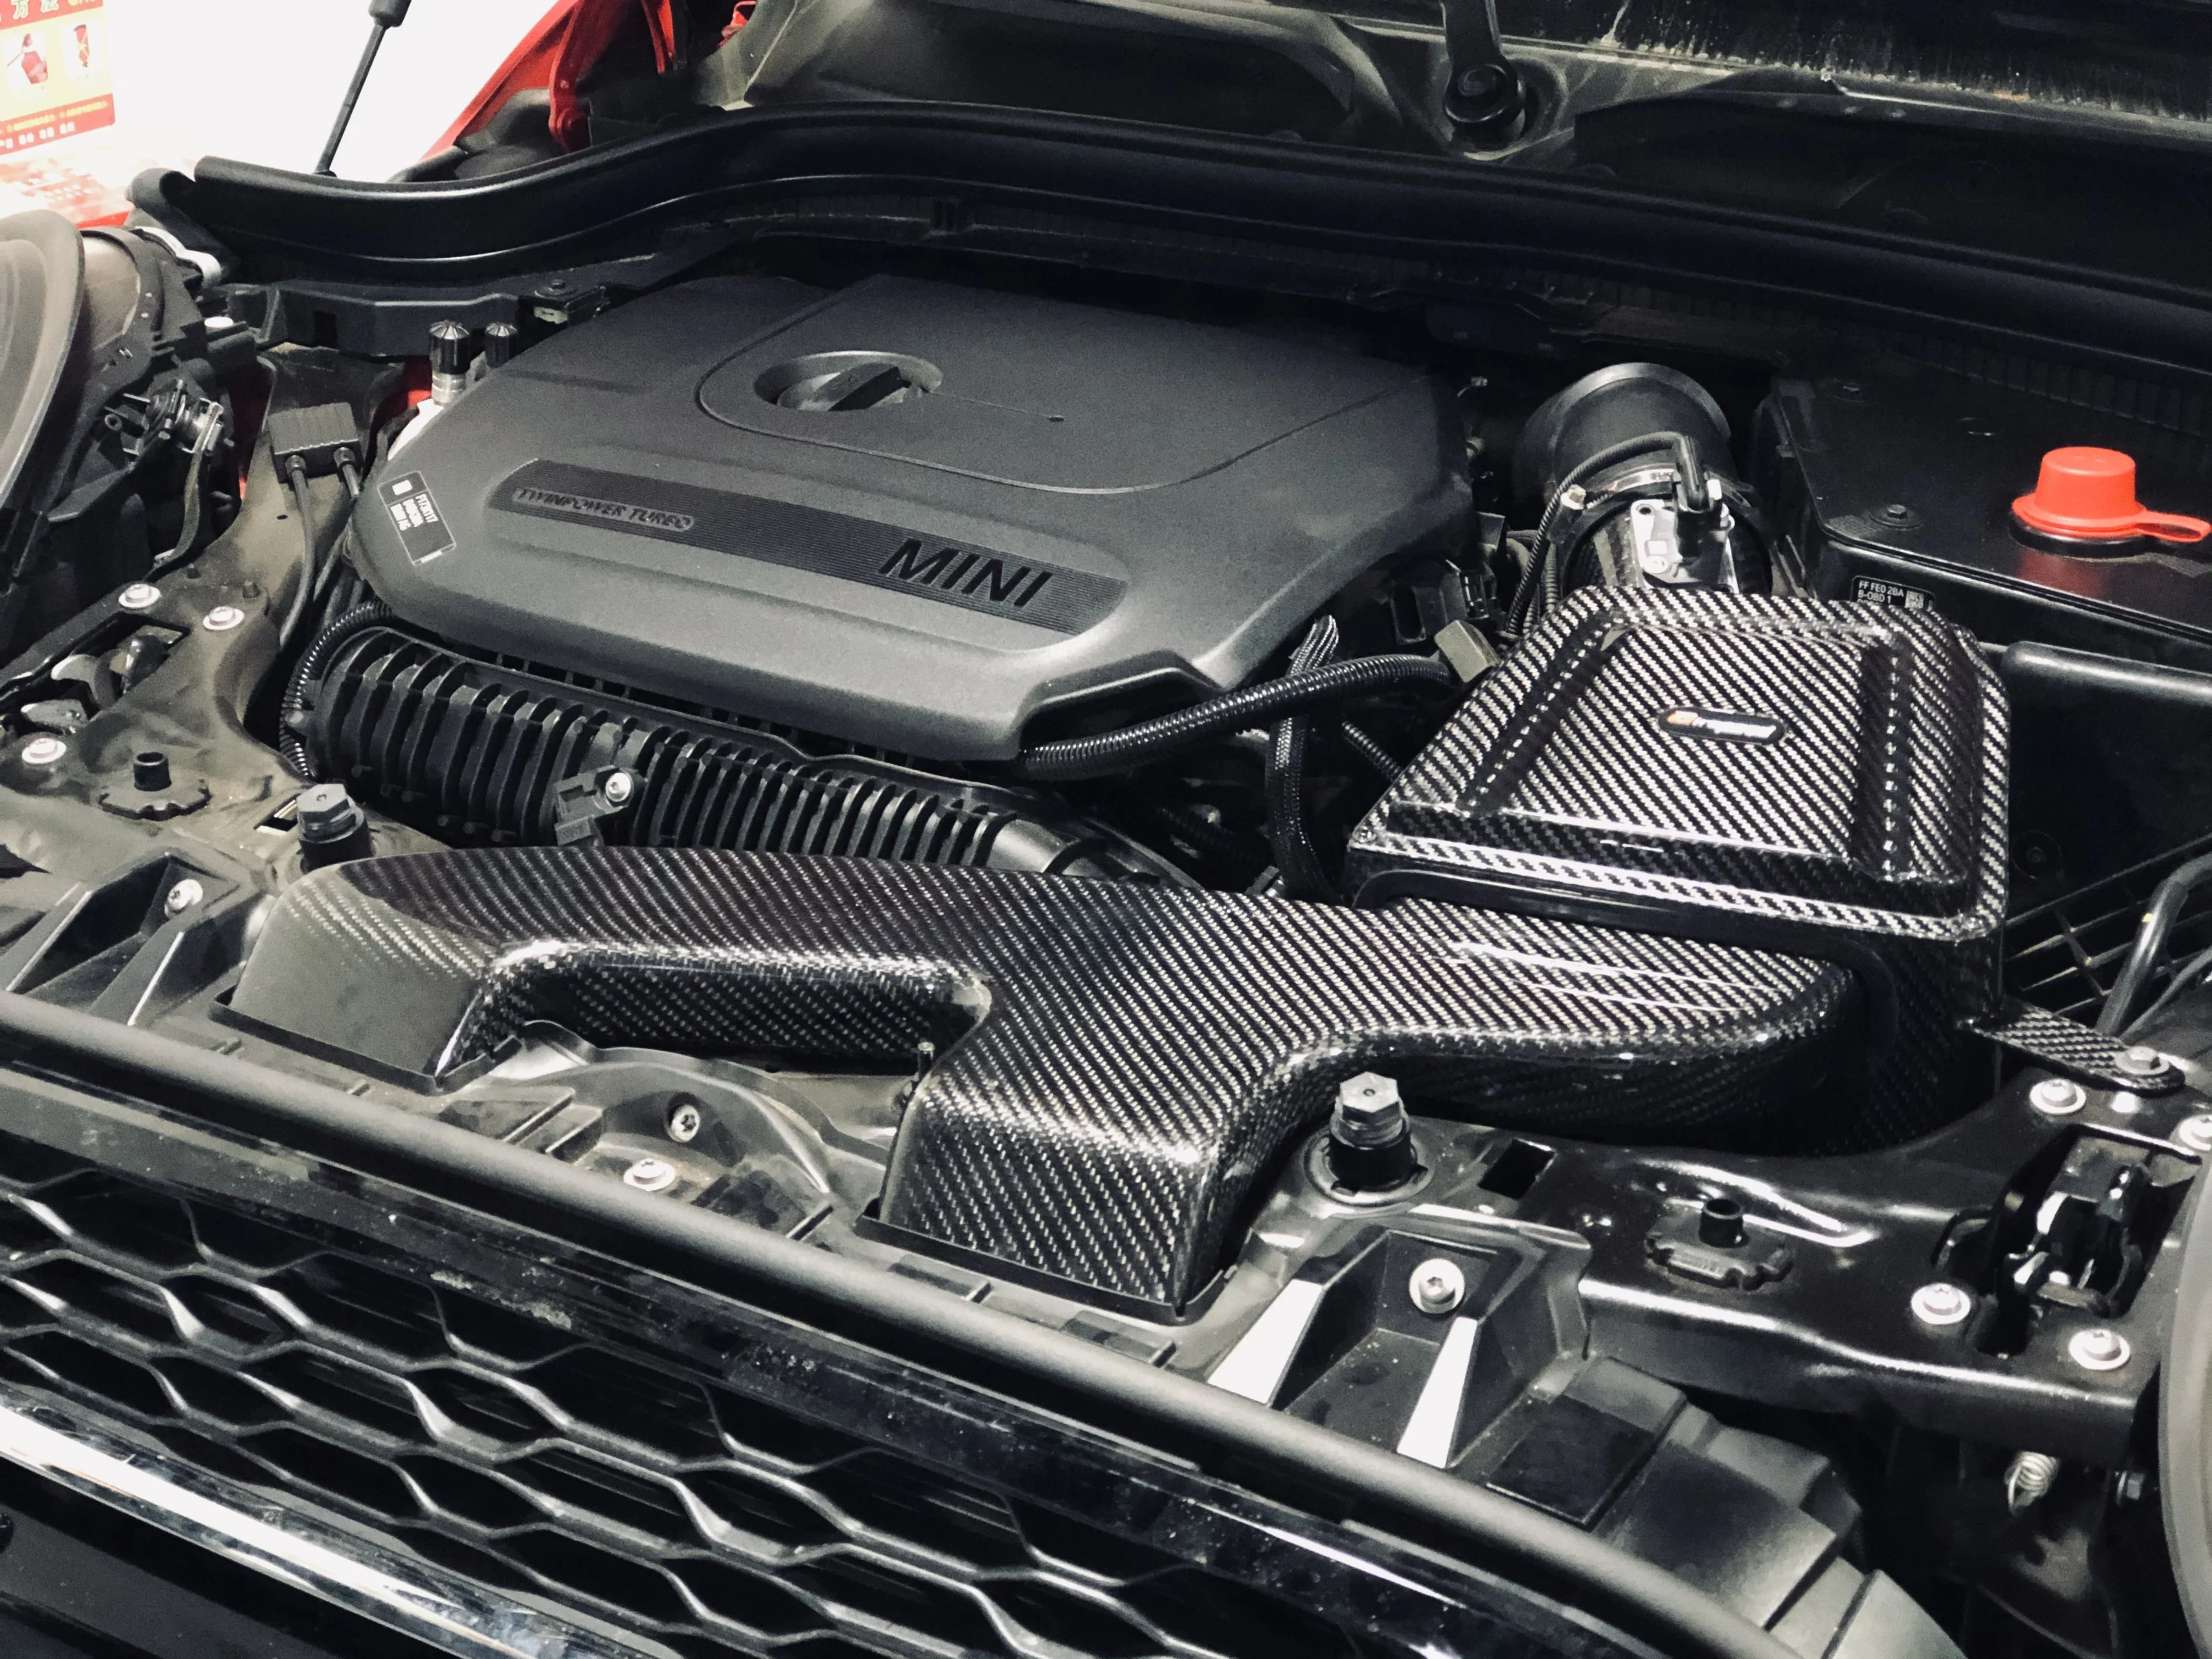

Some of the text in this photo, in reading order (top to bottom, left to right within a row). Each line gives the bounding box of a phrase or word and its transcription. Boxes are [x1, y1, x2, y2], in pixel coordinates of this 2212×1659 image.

[517, 488, 691, 529] TWINPOWER TURBO
[879, 538, 1053, 607] MINI
